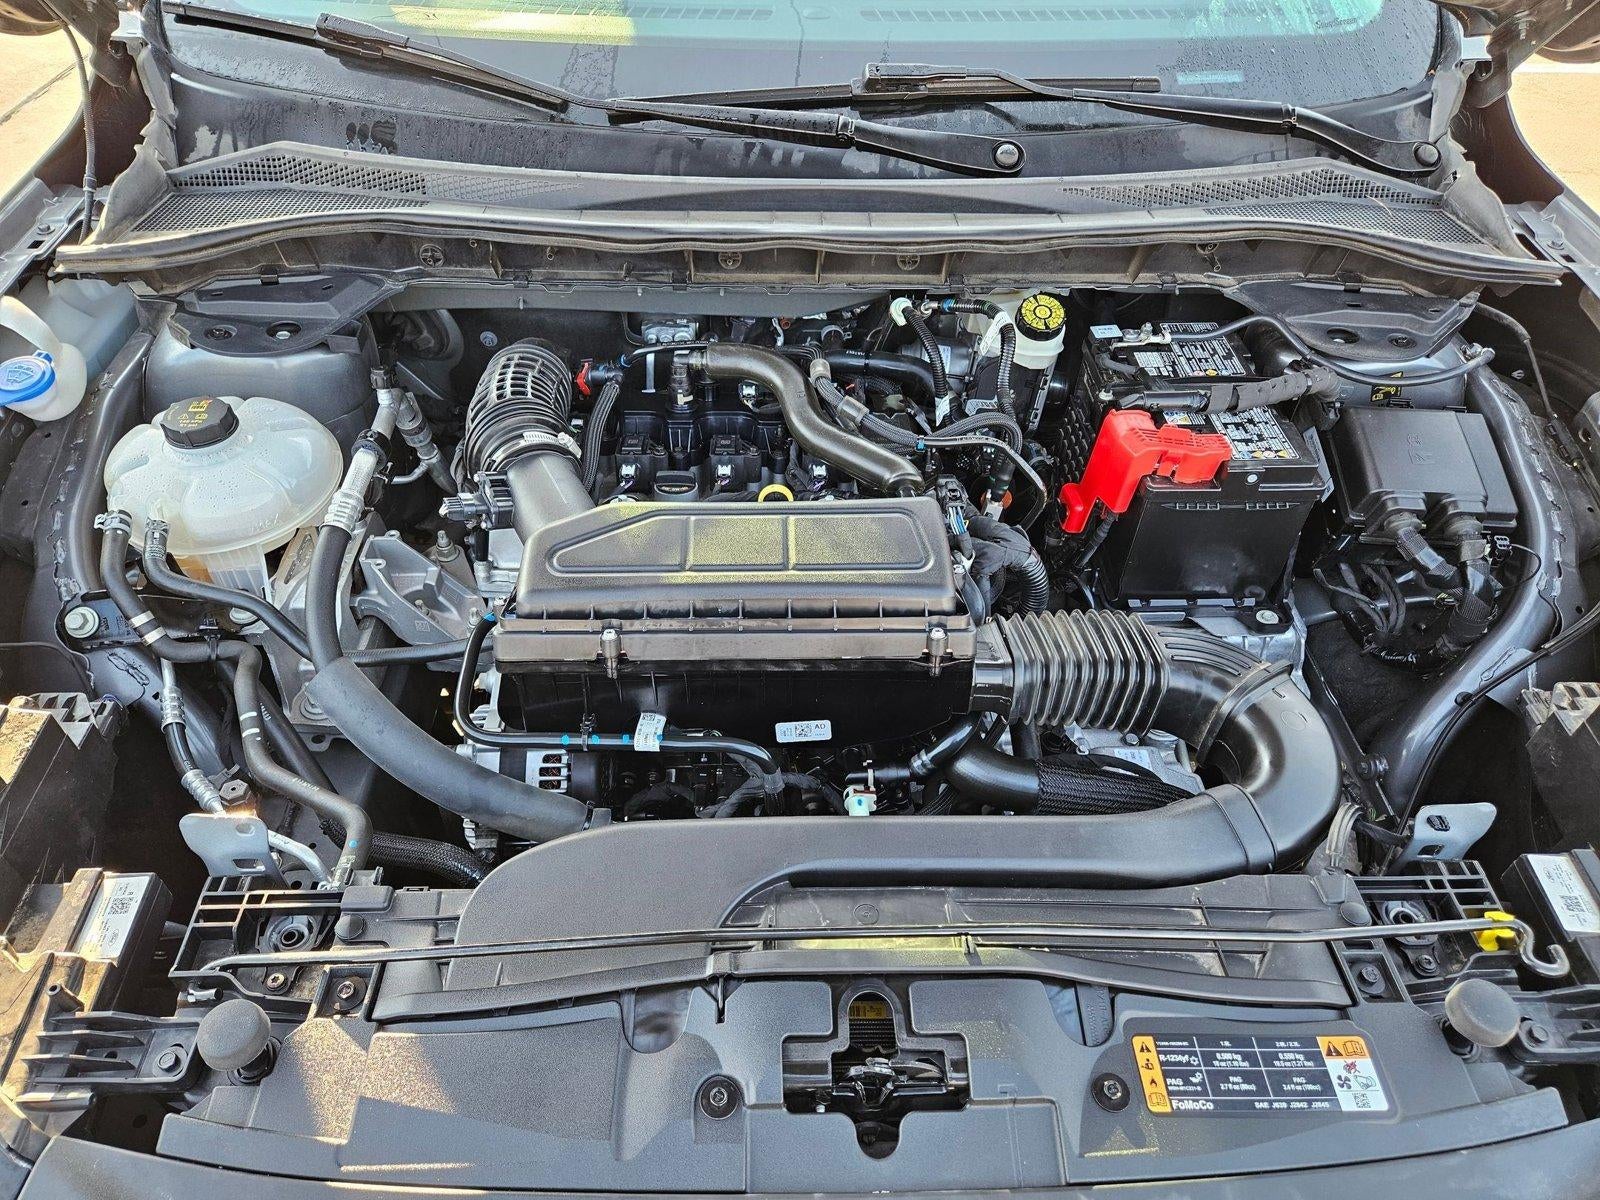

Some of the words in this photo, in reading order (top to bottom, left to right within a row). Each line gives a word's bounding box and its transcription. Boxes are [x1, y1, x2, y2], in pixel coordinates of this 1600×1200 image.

[1159, 1054, 1189, 1063] R-1234yf
[1166, 1078, 1183, 1086] PAG
[1172, 1100, 1214, 1110] FoMoCo
